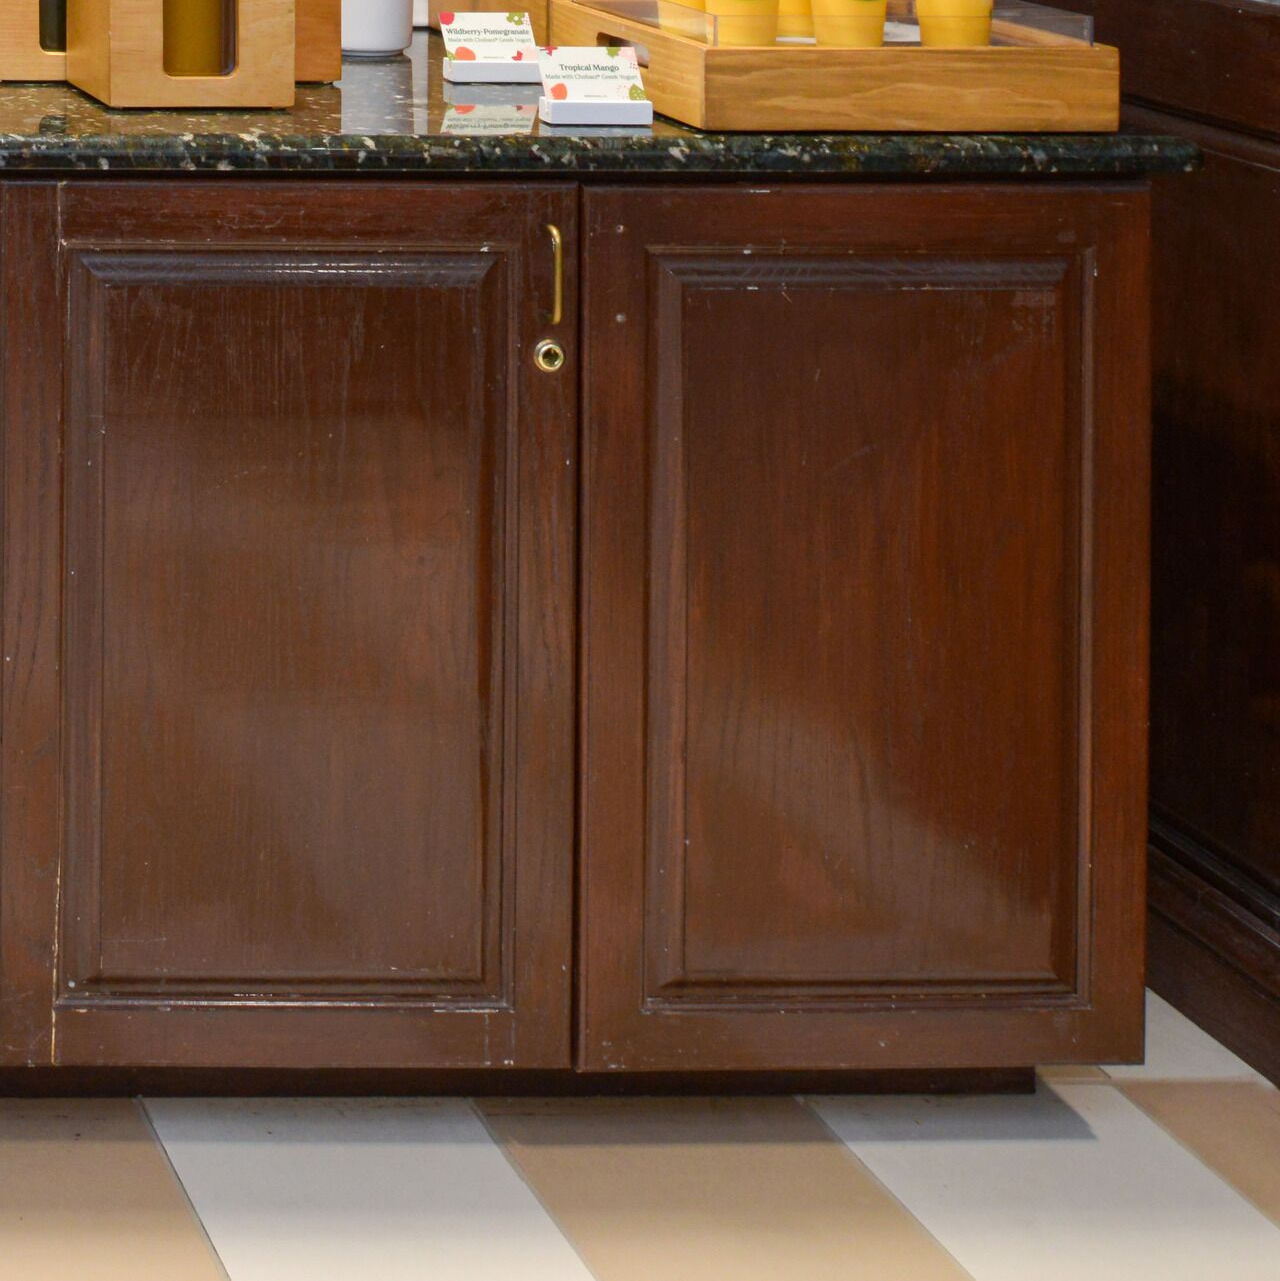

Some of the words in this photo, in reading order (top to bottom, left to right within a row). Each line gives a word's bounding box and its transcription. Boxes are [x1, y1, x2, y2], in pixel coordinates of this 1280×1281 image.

[446, 28, 529, 36] Wildberry-Pomegranate
[558, 63, 592, 72] Tropical
[592, 63, 620, 73] Mango
